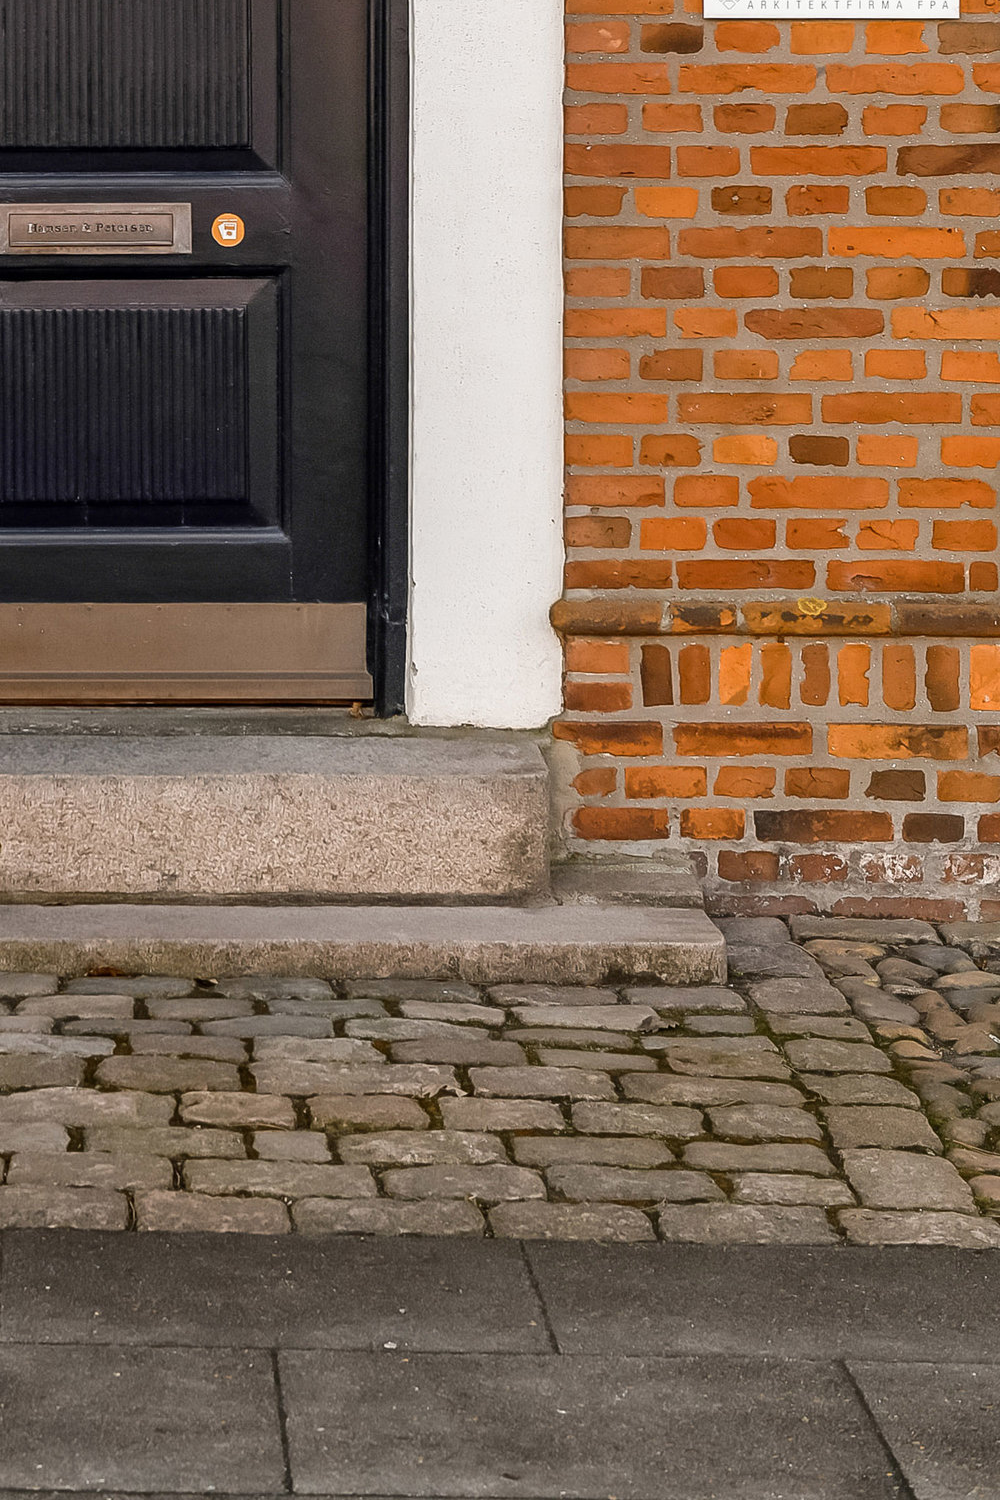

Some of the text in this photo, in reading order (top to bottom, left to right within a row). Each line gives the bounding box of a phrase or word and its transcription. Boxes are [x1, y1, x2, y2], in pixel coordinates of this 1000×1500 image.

[747, 0, 949, 10] ARKITEKTFIRMA FPA
[27, 222, 154, 234] Hansen & Petersen
